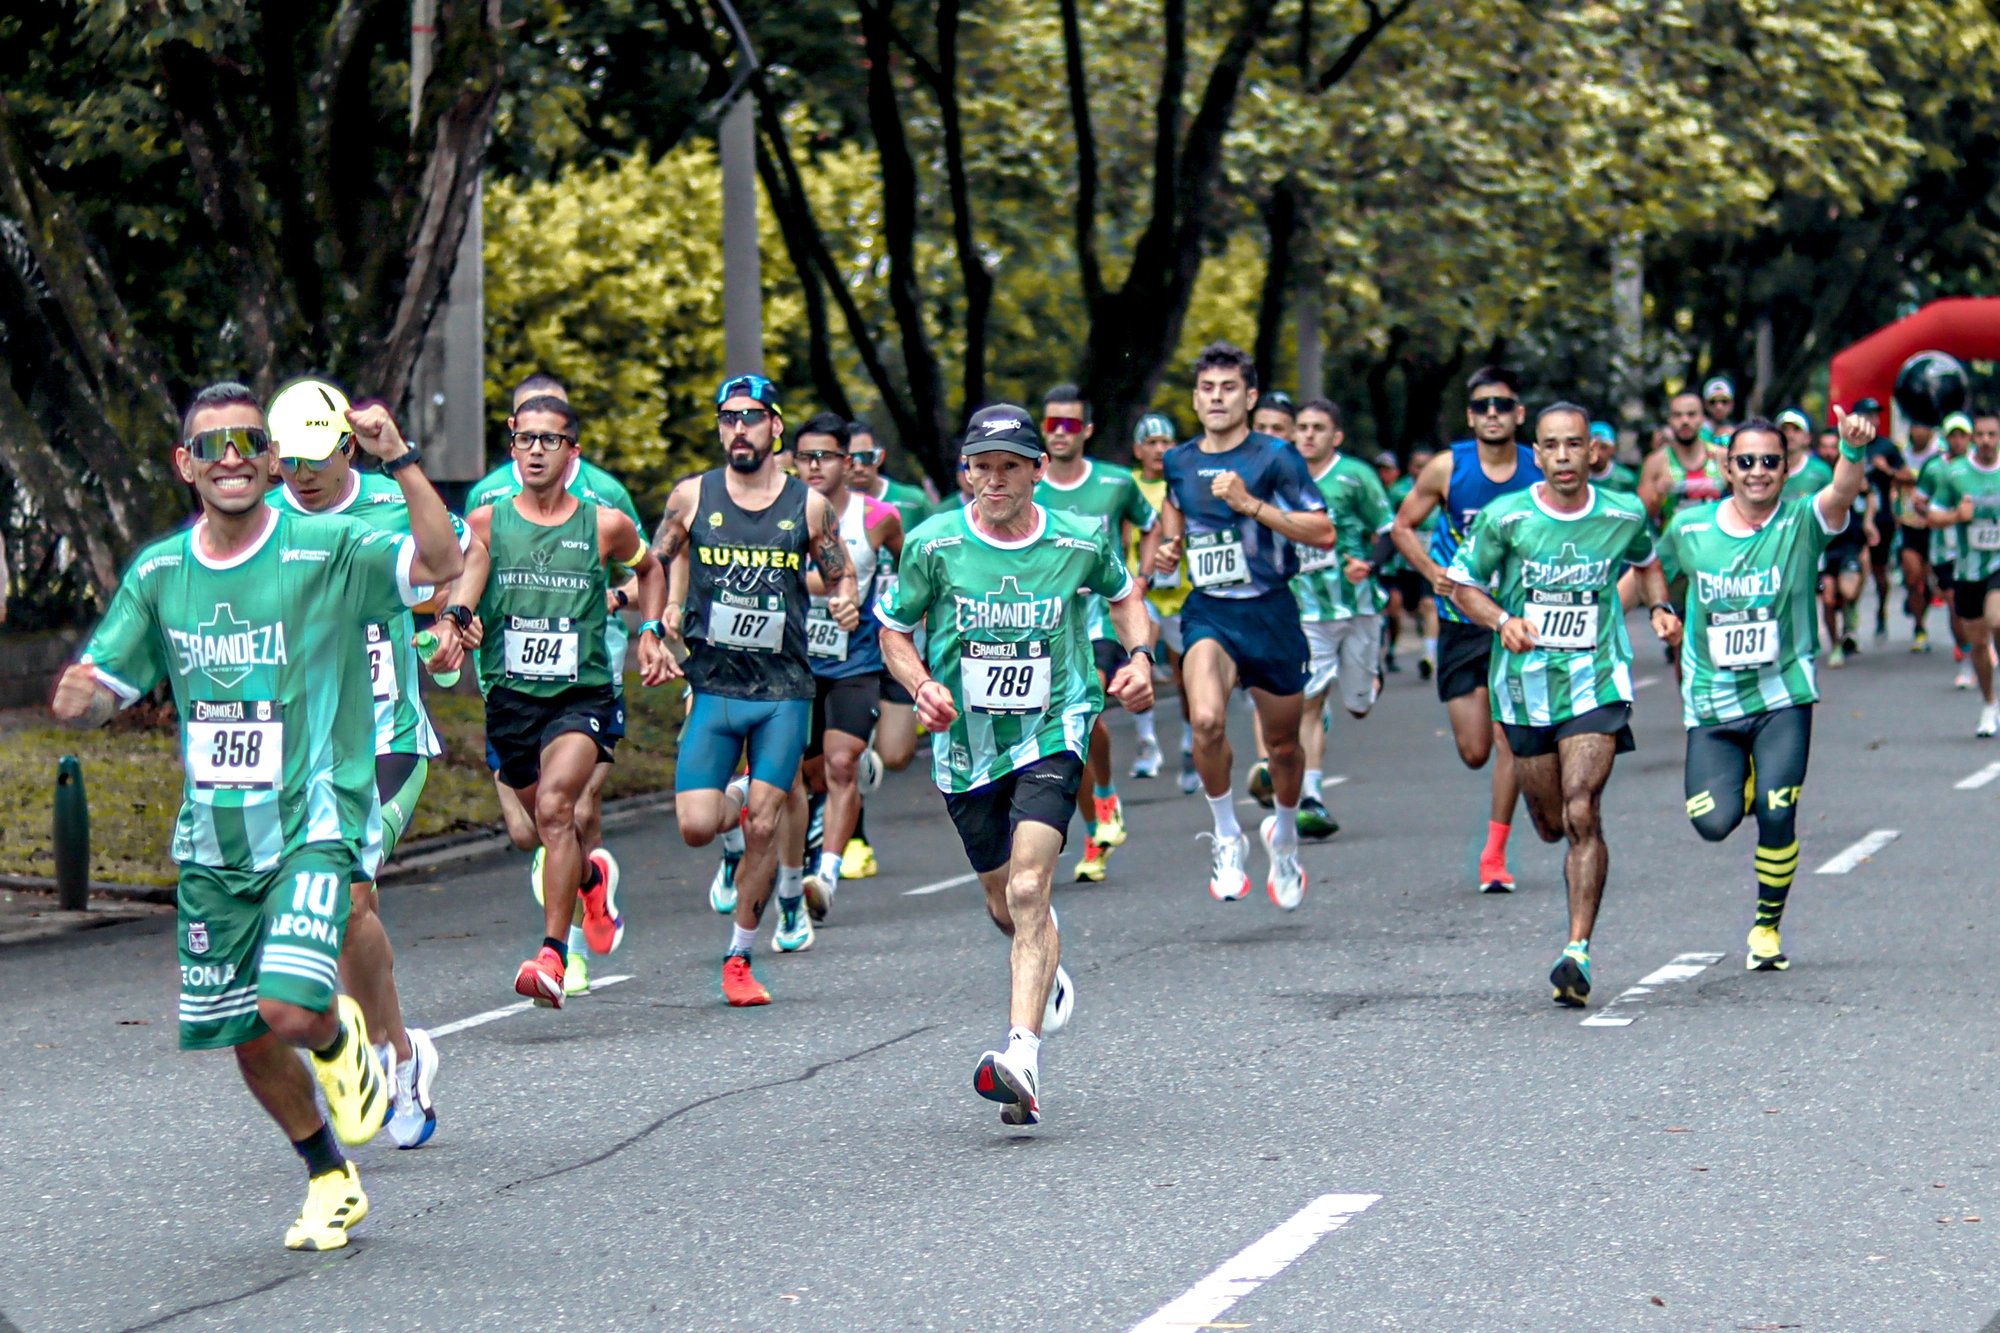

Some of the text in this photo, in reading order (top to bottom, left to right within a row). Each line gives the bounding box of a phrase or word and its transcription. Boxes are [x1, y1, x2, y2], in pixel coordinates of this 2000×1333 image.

[698, 547, 799, 570] RUNNER
[1197, 548, 1236, 578] 1076
[715, 557, 784, 592] Life
[721, 591, 760, 608] GRANDEZA
[511, 615, 549, 631] GRANDEZA
[730, 612, 770, 639] 167
[954, 595, 1062, 633] GRANDEZA
[1541, 610, 1588, 637] 1105
[168, 621, 287, 676] GRANDEZA
[521, 638, 563, 666] 584
[970, 641, 1017, 658] GRANDEZA
[1725, 627, 1766, 656] 1031
[986, 666, 1034, 697] 789
[196, 700, 244, 720] GRANDEZA
[211, 730, 263, 768] 358
[292, 871, 339, 918] 10
